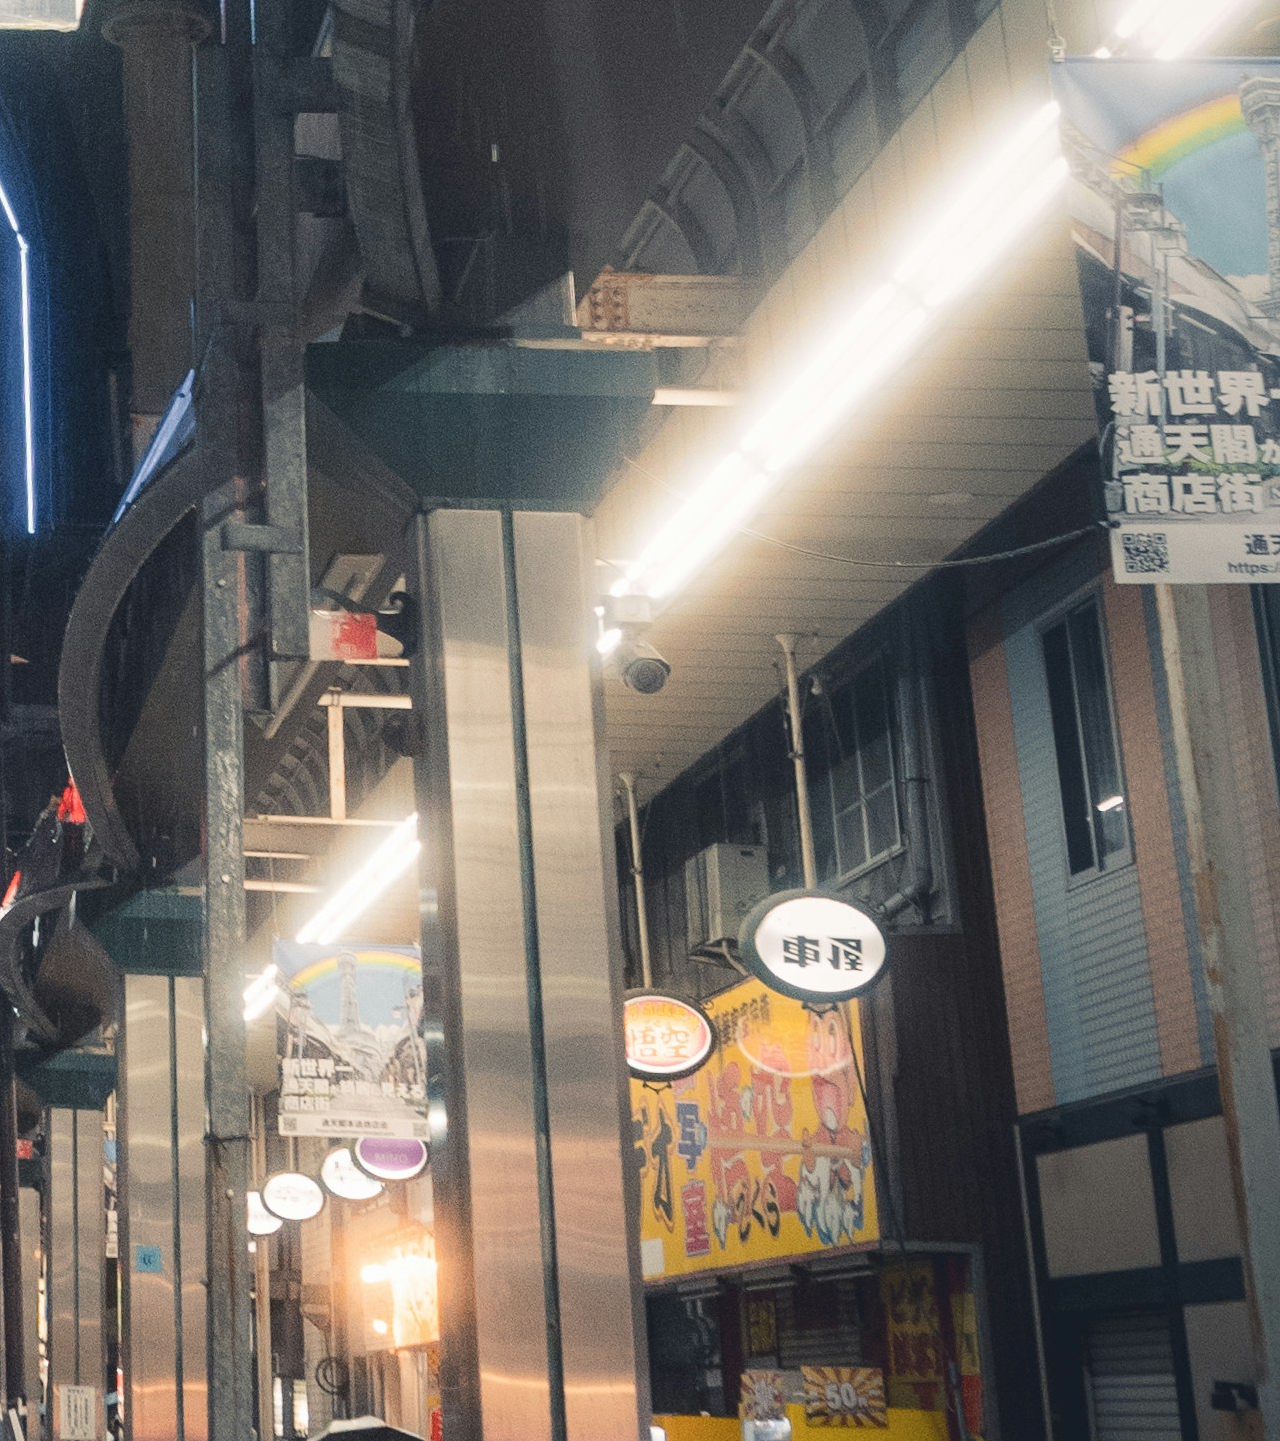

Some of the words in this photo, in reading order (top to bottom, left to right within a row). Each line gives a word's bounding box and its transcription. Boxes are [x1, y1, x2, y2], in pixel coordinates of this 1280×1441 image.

[1108, 370, 1280, 417] 新世界
[1121, 473, 1263, 514] 商店街
